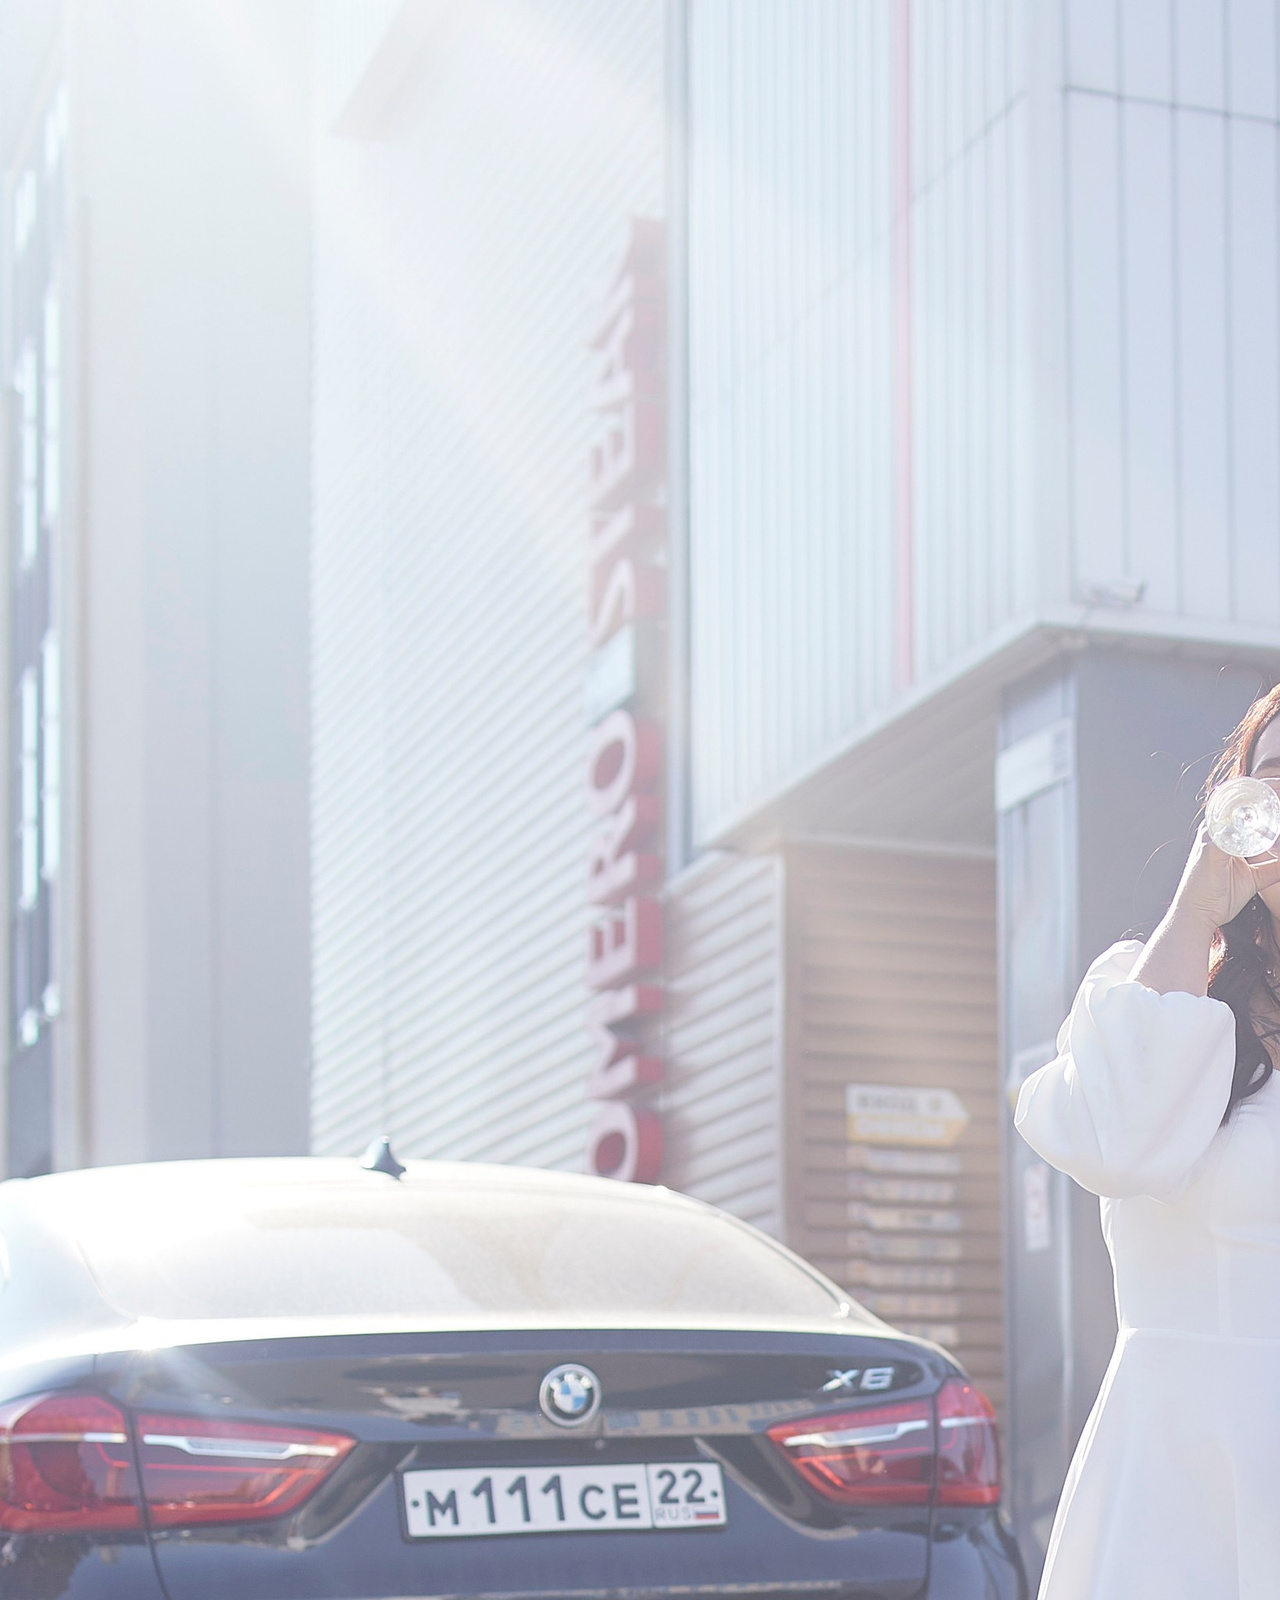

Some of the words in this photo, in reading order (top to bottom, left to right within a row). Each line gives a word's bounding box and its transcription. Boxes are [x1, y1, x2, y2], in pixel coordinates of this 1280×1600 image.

[818, 1366, 895, 1392] X6
[656, 1469, 707, 1505] 22
[655, 1506, 692, 1521] RUS
